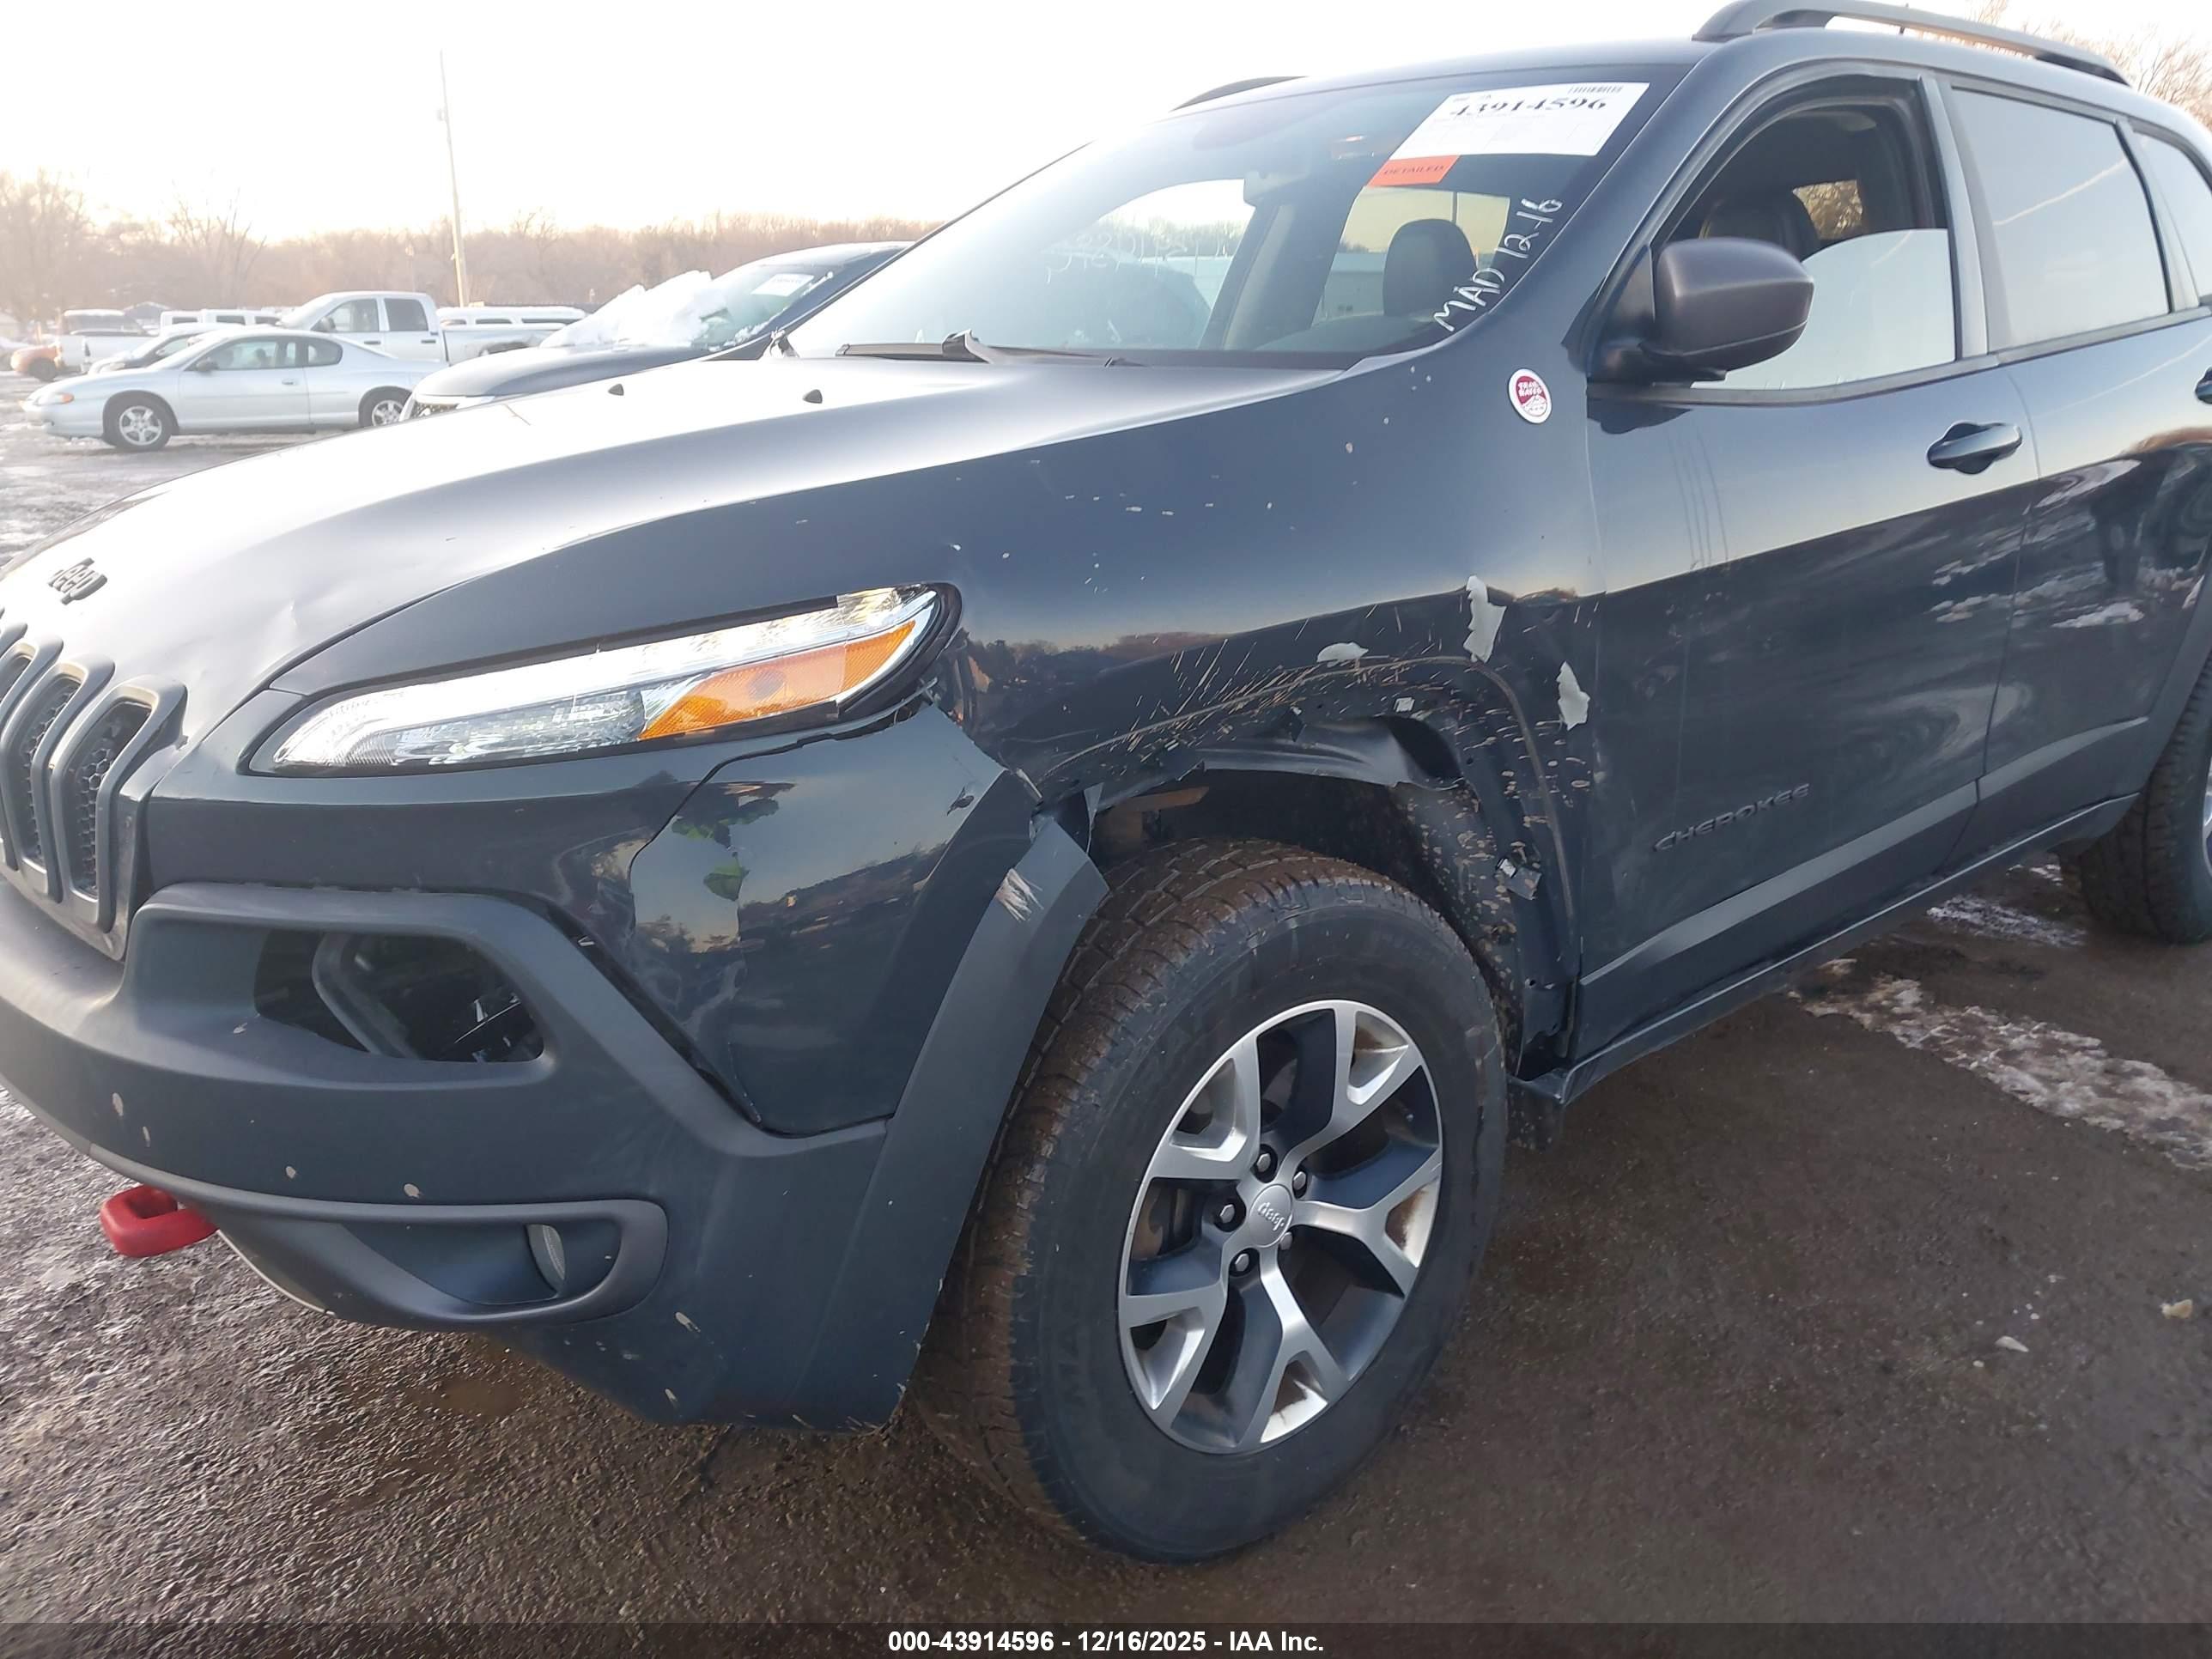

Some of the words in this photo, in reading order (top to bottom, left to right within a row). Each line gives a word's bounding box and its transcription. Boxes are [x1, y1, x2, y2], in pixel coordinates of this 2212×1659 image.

[1449, 96, 1607, 116] 43914596
[1433, 267, 1505, 332] MAD
[1494, 198, 1563, 258] 12-16
[47, 557, 108, 606] Jeep
[1654, 782, 1810, 851] CHEROKEE
